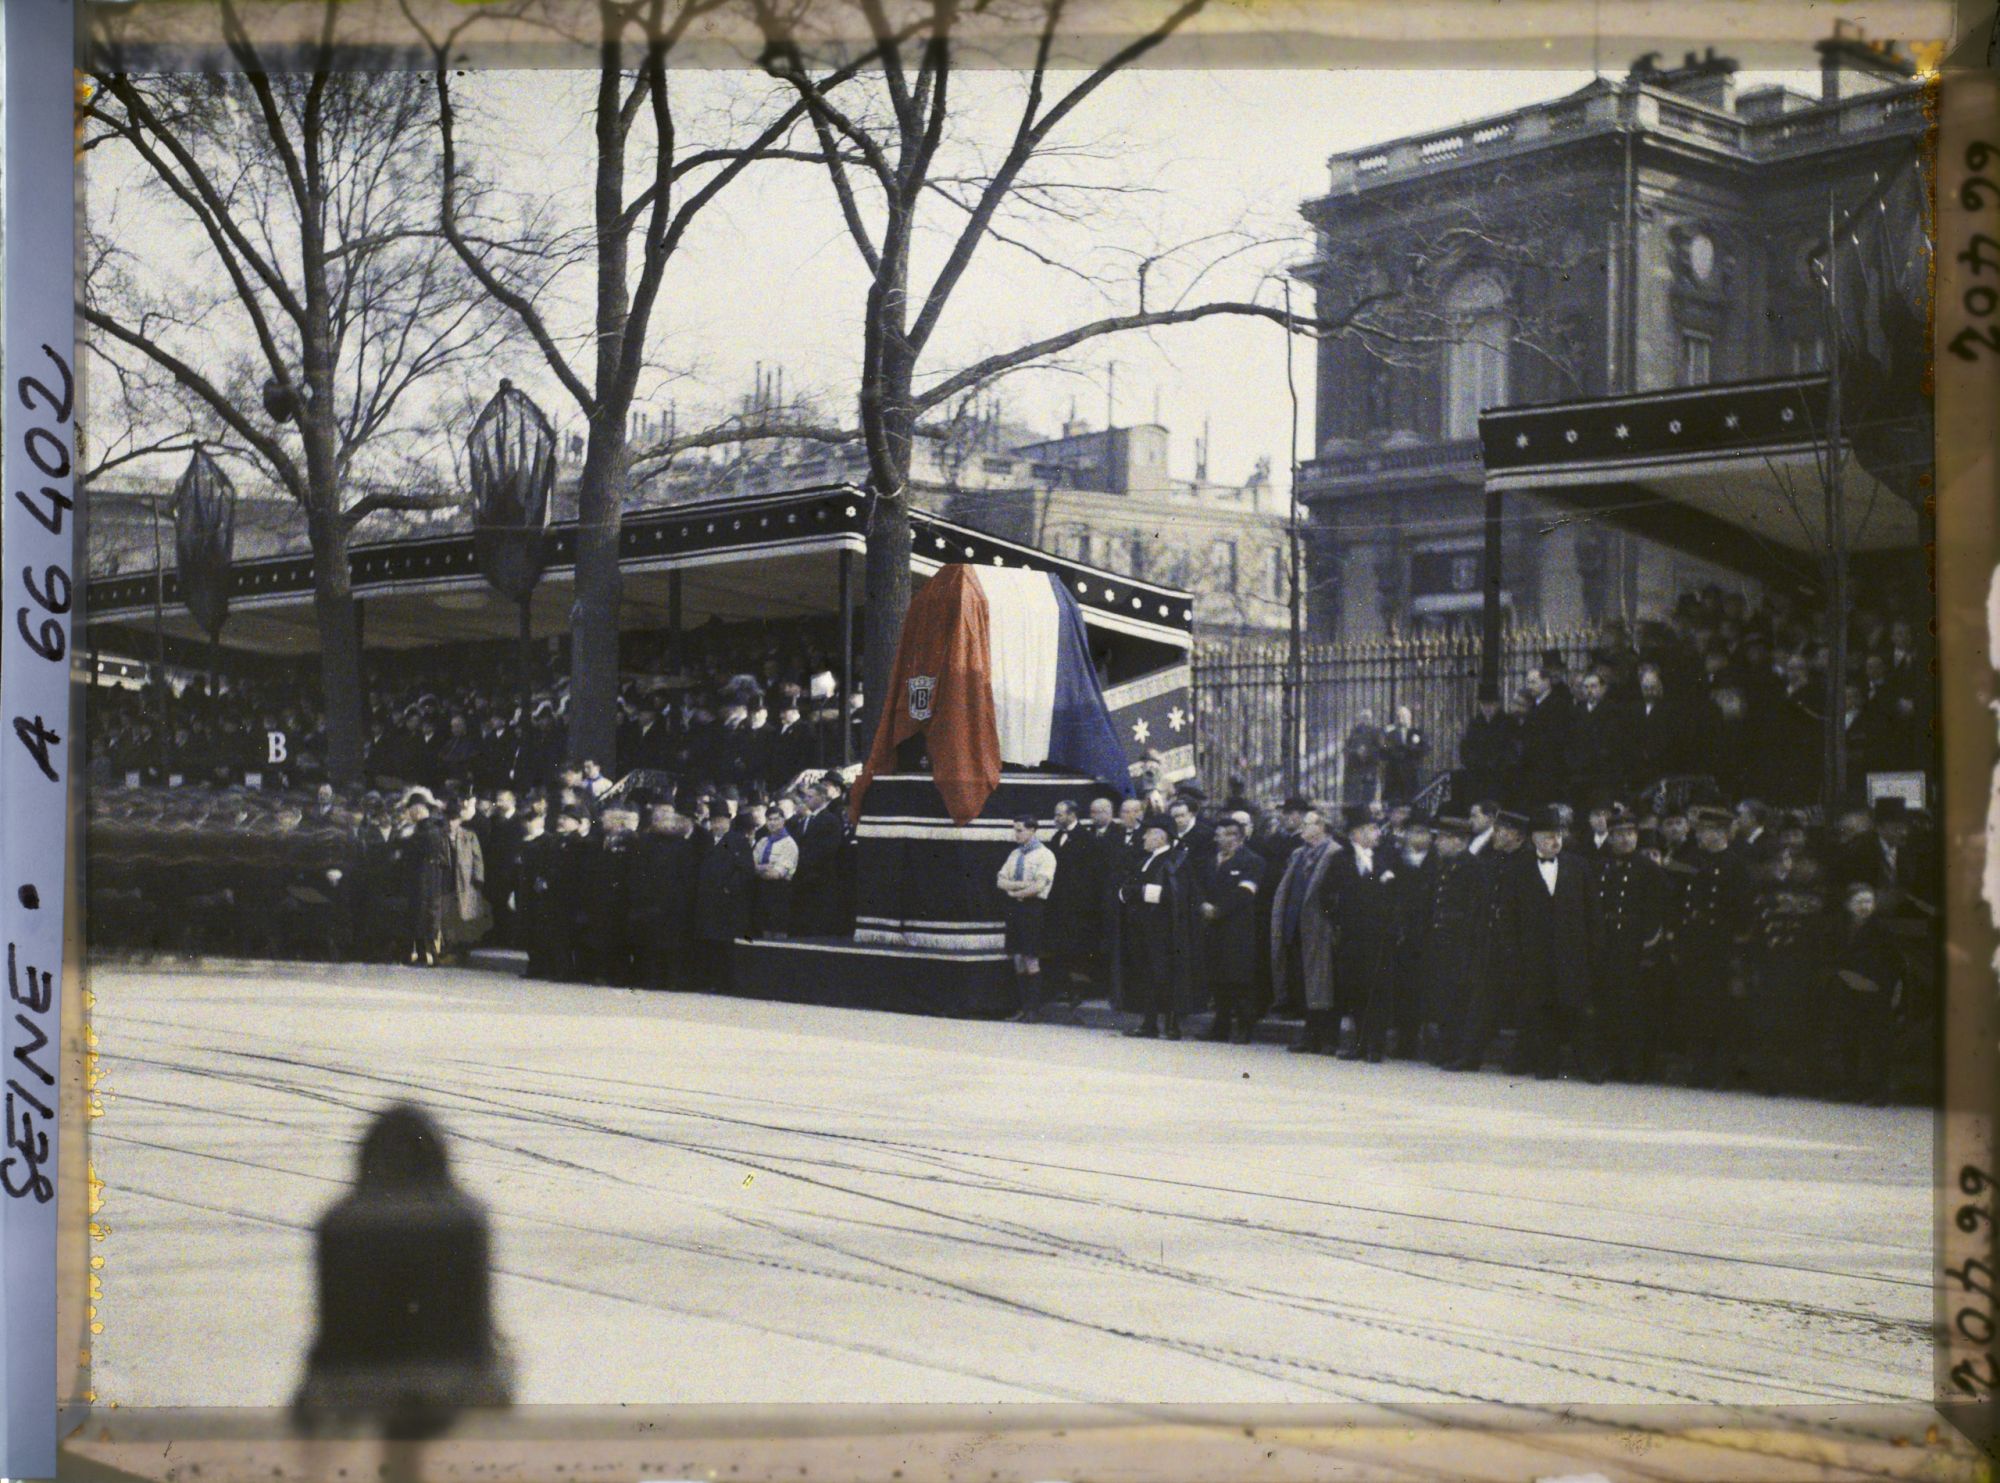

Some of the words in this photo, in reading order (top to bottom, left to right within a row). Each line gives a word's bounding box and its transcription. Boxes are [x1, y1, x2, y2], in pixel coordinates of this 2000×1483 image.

[13, 715, 61, 782] A
[267, 731, 287, 763] B
[1, 942, 54, 1202] SEINE
